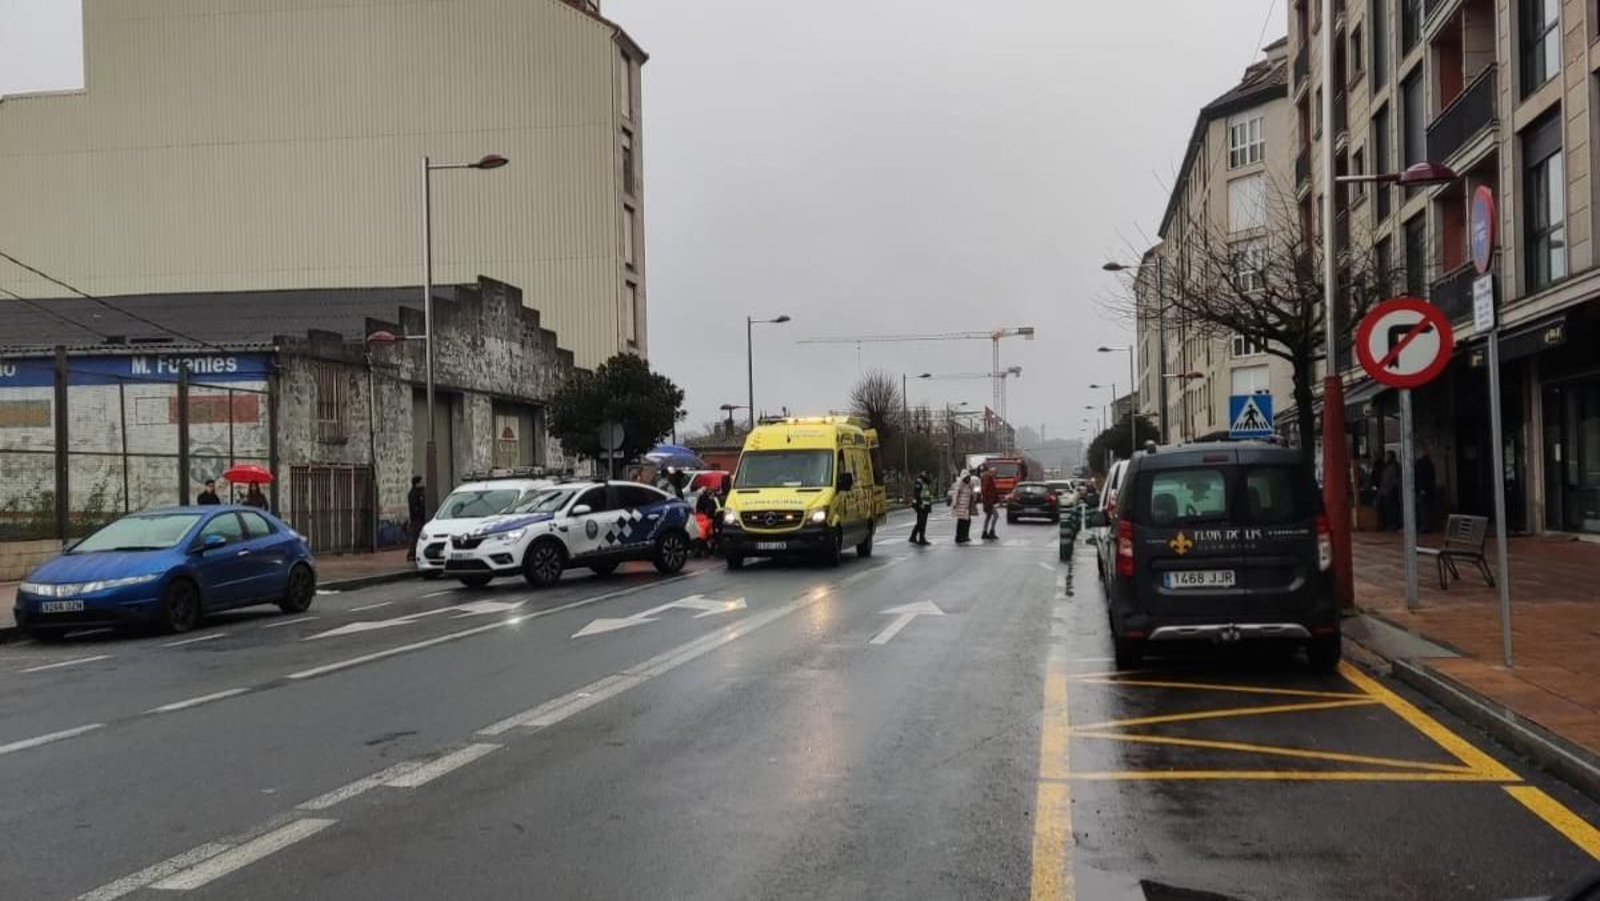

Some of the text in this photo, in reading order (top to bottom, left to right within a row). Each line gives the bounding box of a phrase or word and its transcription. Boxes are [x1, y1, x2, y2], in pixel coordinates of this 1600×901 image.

[131, 358, 151, 374] M.
[1174, 571, 1233, 584] 1468 JJR
